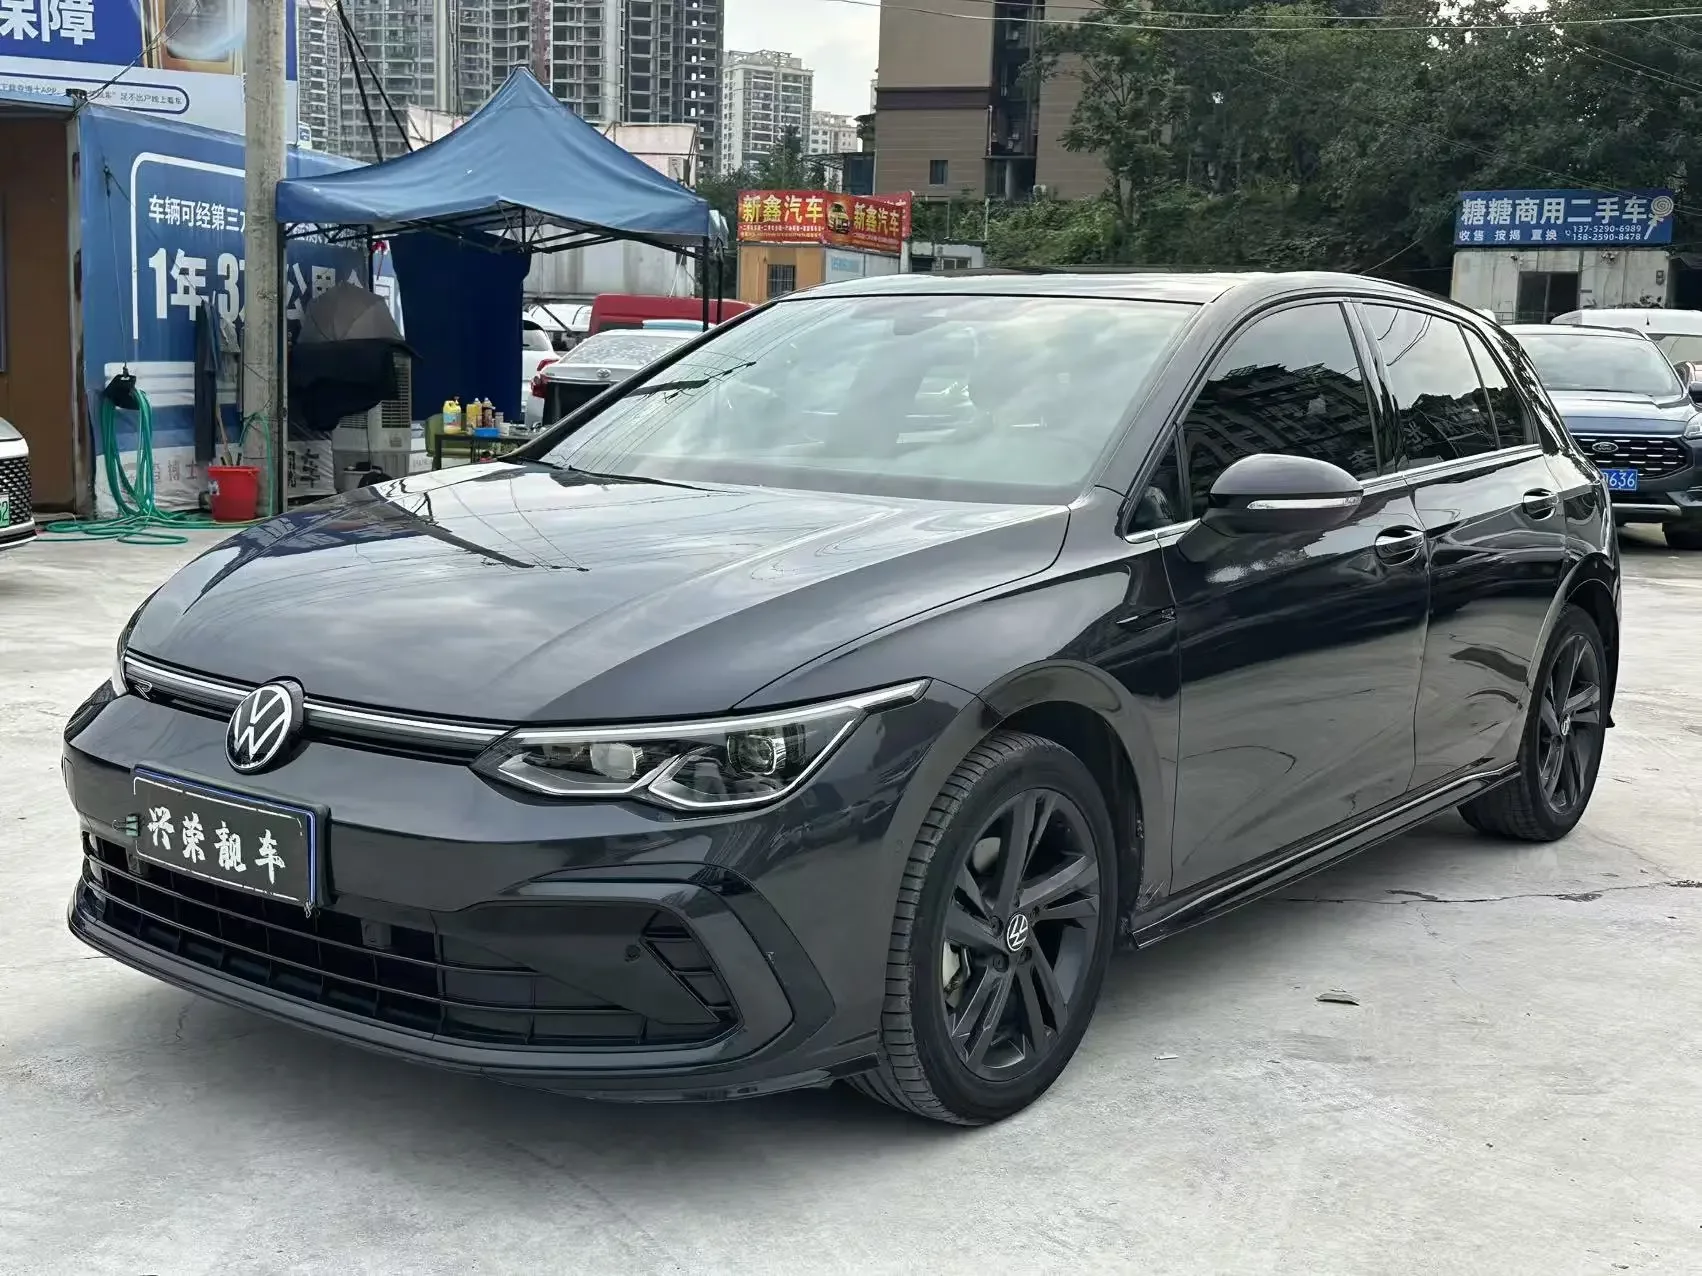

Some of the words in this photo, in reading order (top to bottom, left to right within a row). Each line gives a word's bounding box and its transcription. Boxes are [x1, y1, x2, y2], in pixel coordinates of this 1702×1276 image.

[148, 194, 246, 233] 车辆可经第三
[742, 194, 824, 224] 新鑫汽车
[853, 201, 900, 237] 新鑫汽车
[1461, 196, 1648, 225] 糖糖商用二手车
[1494, 229, 1521, 242] 按揭
[1572, 224, 1642, 233] 137-5290-6989
[1572, 233, 1641, 241] 158-2590-8478
[148, 247, 246, 322] 1年3
[147, 806, 286, 885] 兴荣靓车
